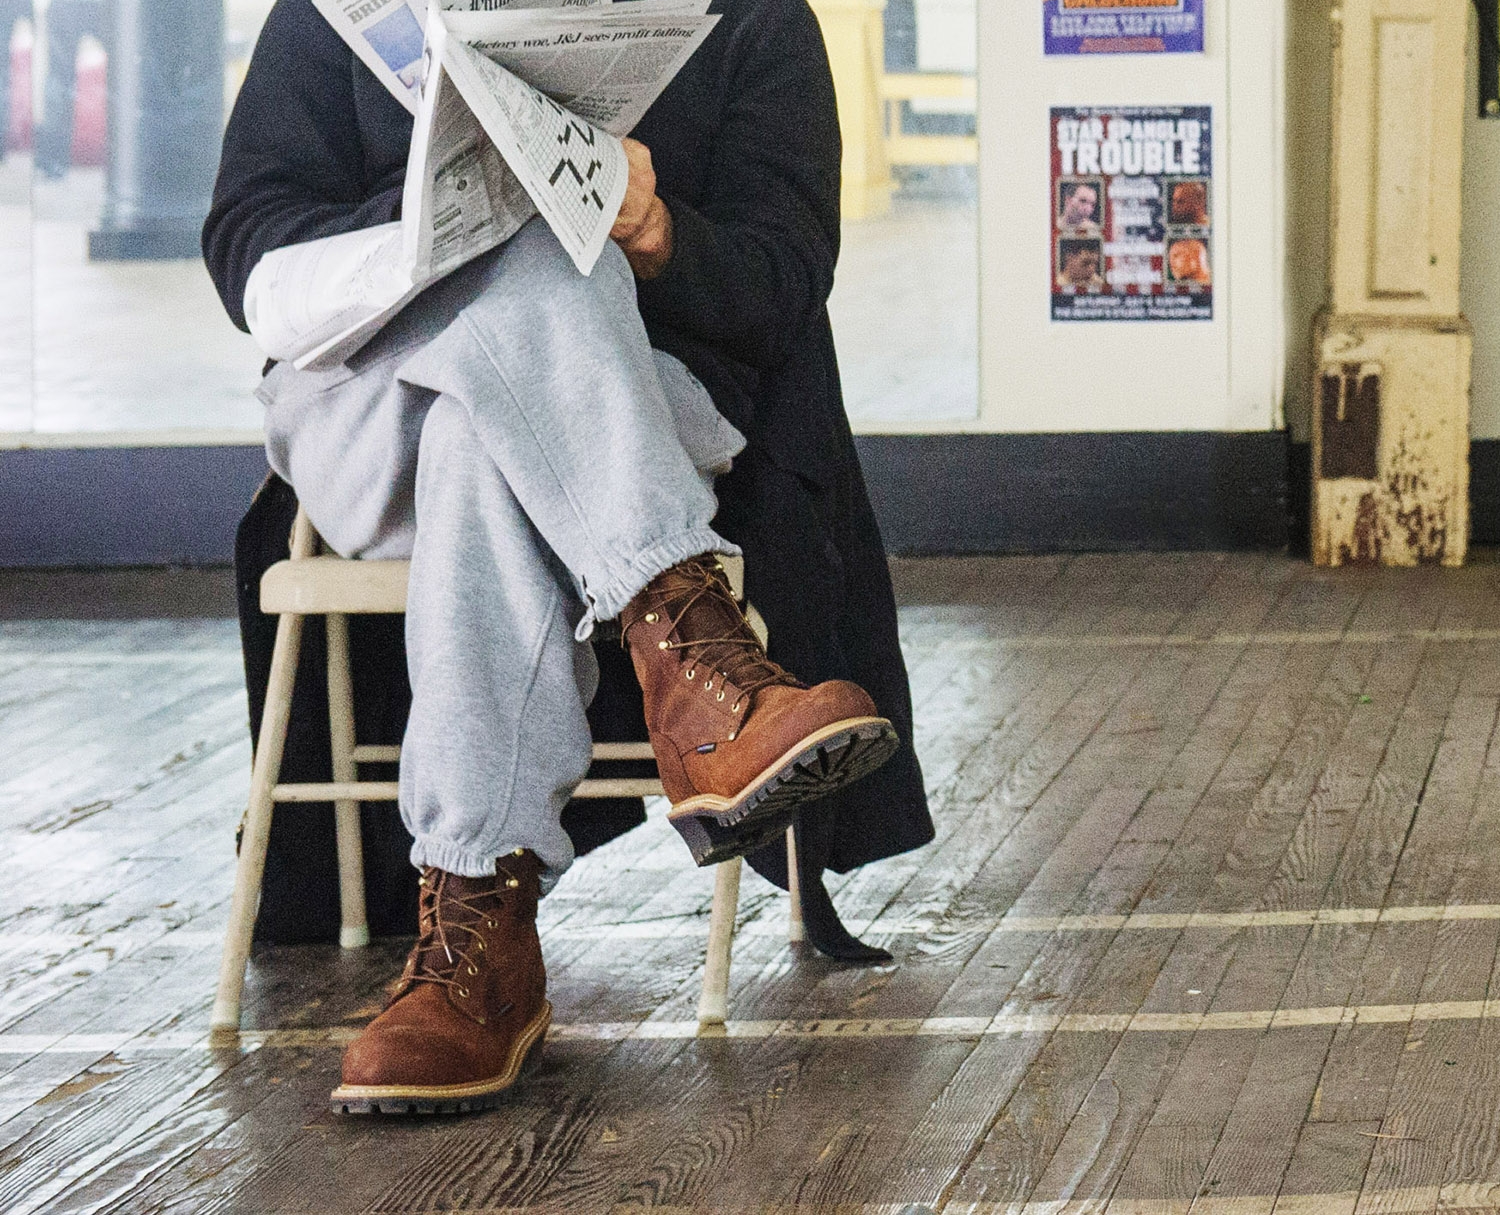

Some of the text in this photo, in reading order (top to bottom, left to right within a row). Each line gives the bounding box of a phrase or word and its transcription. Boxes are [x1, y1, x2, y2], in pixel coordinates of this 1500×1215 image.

[553, 32, 582, 45] J&J
[611, 27, 651, 42] profit
[652, 26, 697, 39] falling
[1058, 139, 1202, 175] TROUBLE
